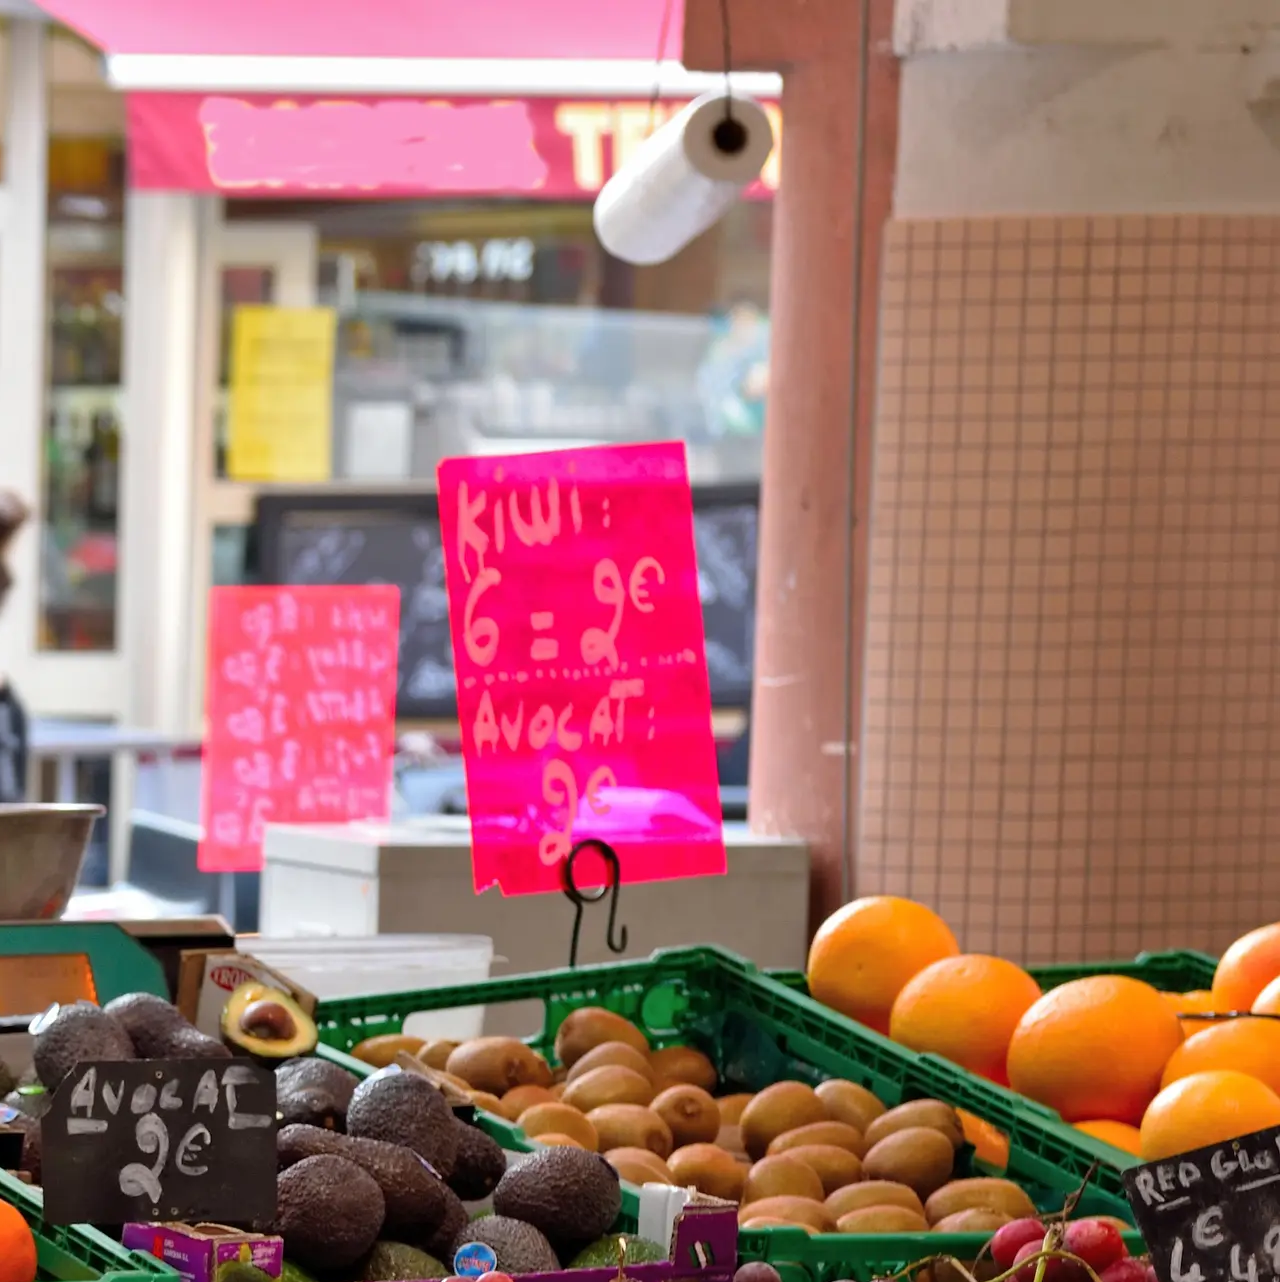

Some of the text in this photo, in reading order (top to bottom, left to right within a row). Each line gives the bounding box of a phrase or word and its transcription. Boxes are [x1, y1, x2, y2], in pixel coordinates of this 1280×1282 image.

[464, 567, 502, 667] 6
[70, 1065, 260, 1118] AVOCAT
[1135, 1136, 1280, 1206] RED GLO
